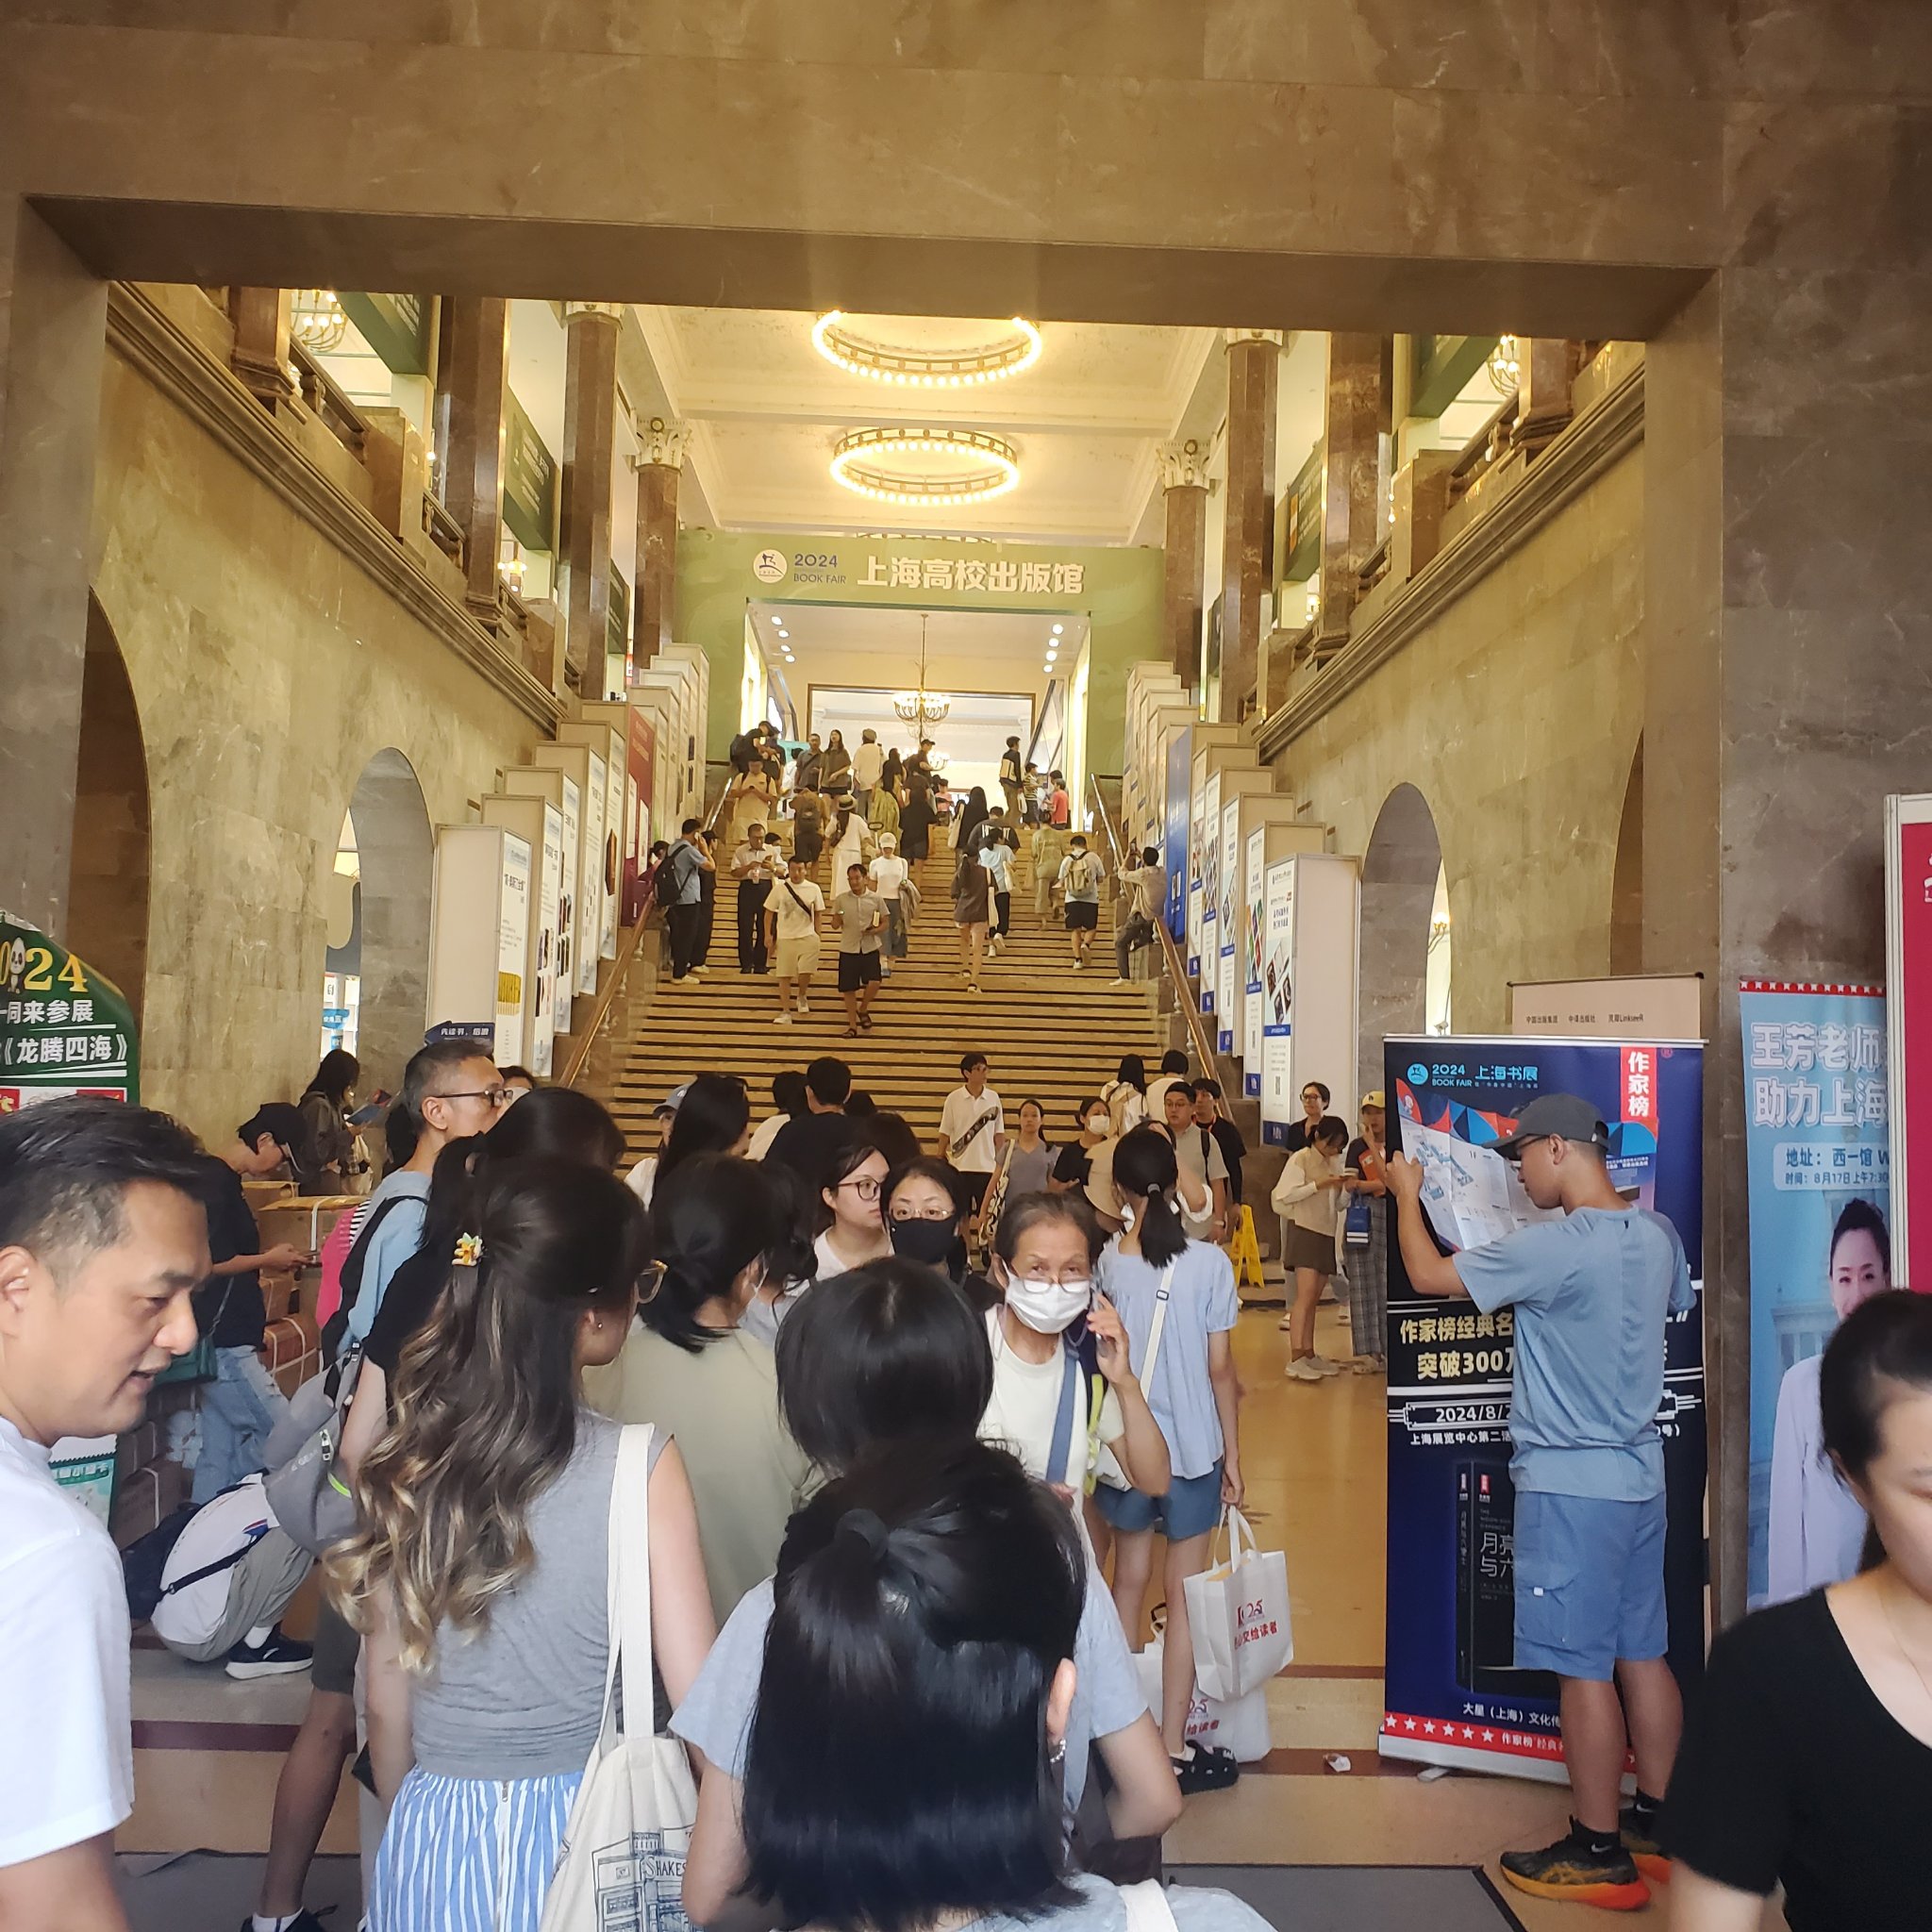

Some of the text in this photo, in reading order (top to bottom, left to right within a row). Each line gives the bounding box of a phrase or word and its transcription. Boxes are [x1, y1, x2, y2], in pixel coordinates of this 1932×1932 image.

[794, 553, 838, 567] 2024
[793, 574, 846, 584] BOOK FAIR
[857, 555, 1084, 594] 上海高校出版馆
[0, 1034, 127, 1065] 《龙腾四海》
[1751, 1022, 1880, 1073] 王芳老师
[1431, 1063, 1465, 1075] 2024
[1474, 1065, 1539, 1081] 上海书展
[1431, 1078, 1455, 1087] BOOK
[1456, 1078, 1473, 1088] FAIR
[1627, 1051, 1650, 1118] 作家榜
[1753, 1076, 1887, 1128] 助力上海
[1832, 1147, 1873, 1167] 西一馆
